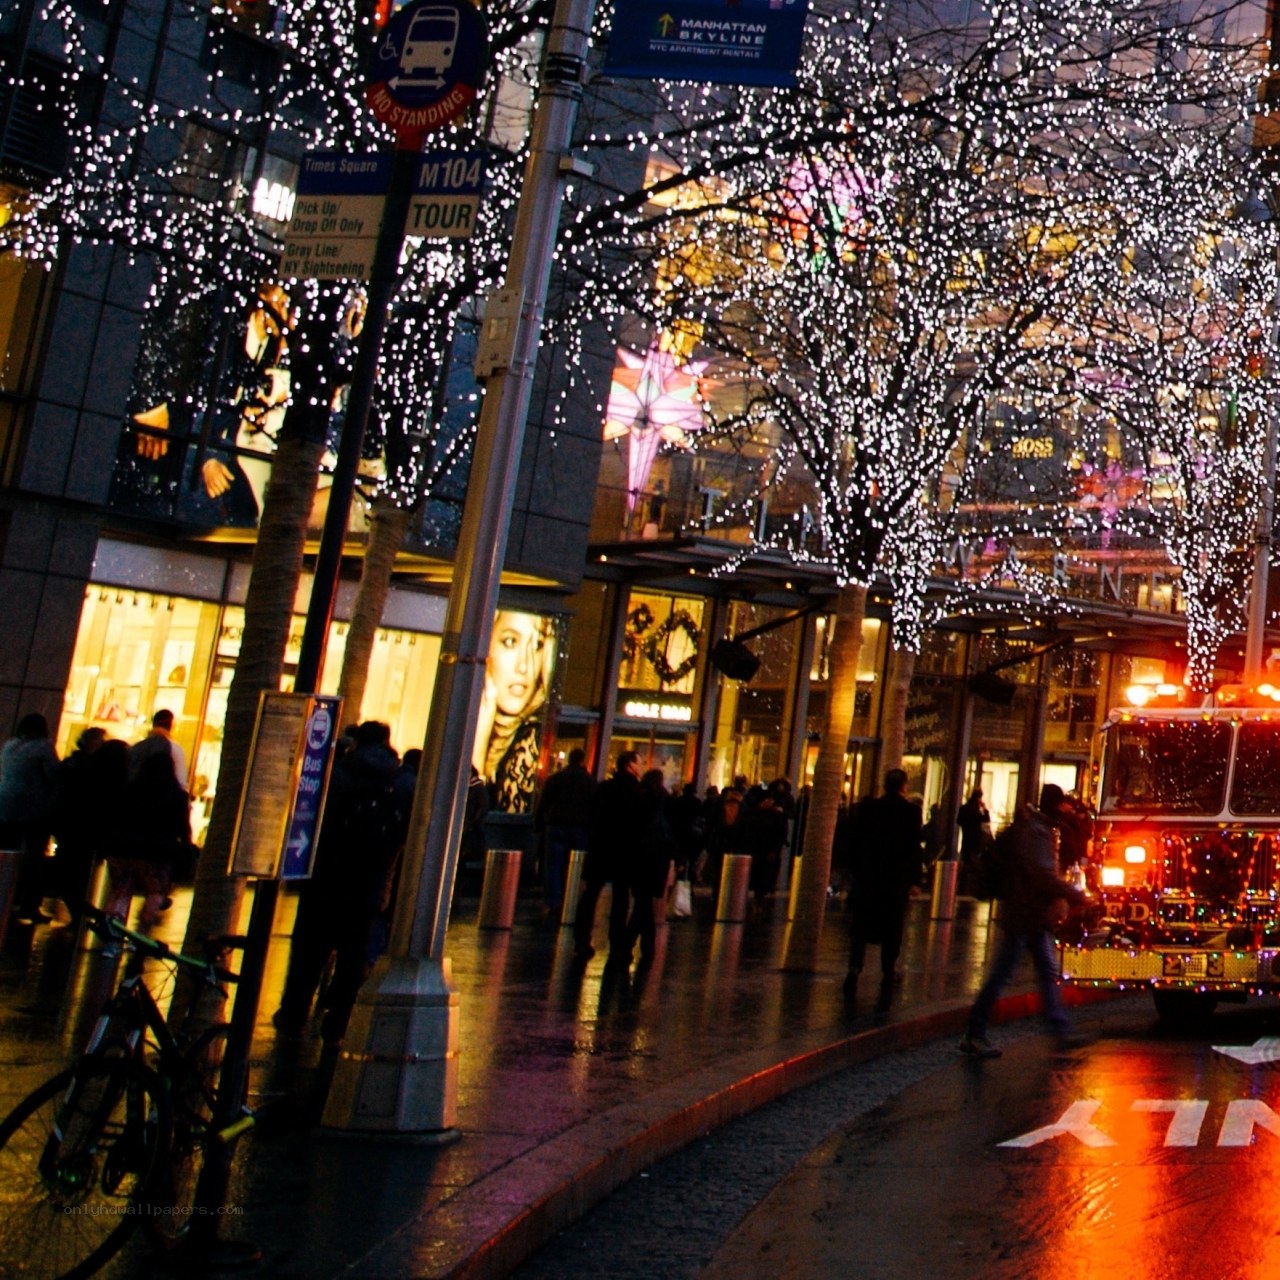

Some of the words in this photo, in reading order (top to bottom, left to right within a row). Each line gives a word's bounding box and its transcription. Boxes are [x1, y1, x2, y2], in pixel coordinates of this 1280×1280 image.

[681, 19, 767, 34] MANHATTAN
[679, 30, 765, 45] SKYLINE
[669, 45, 720, 56] APARTMENT
[372, 89, 392, 113] NO
[391, 89, 465, 128] STANDING
[305, 158, 336, 172] Times
[340, 158, 378, 174] Square
[418, 157, 482, 189] M104
[296, 201, 318, 214] Pick
[413, 203, 472, 229] TOUR
[340, 220, 364, 234] Only
[284, 261, 299, 272] NY
[303, 261, 365, 276] Sightseeing
[304, 755, 321, 771] Bus
[299, 776, 321, 795] Stop
